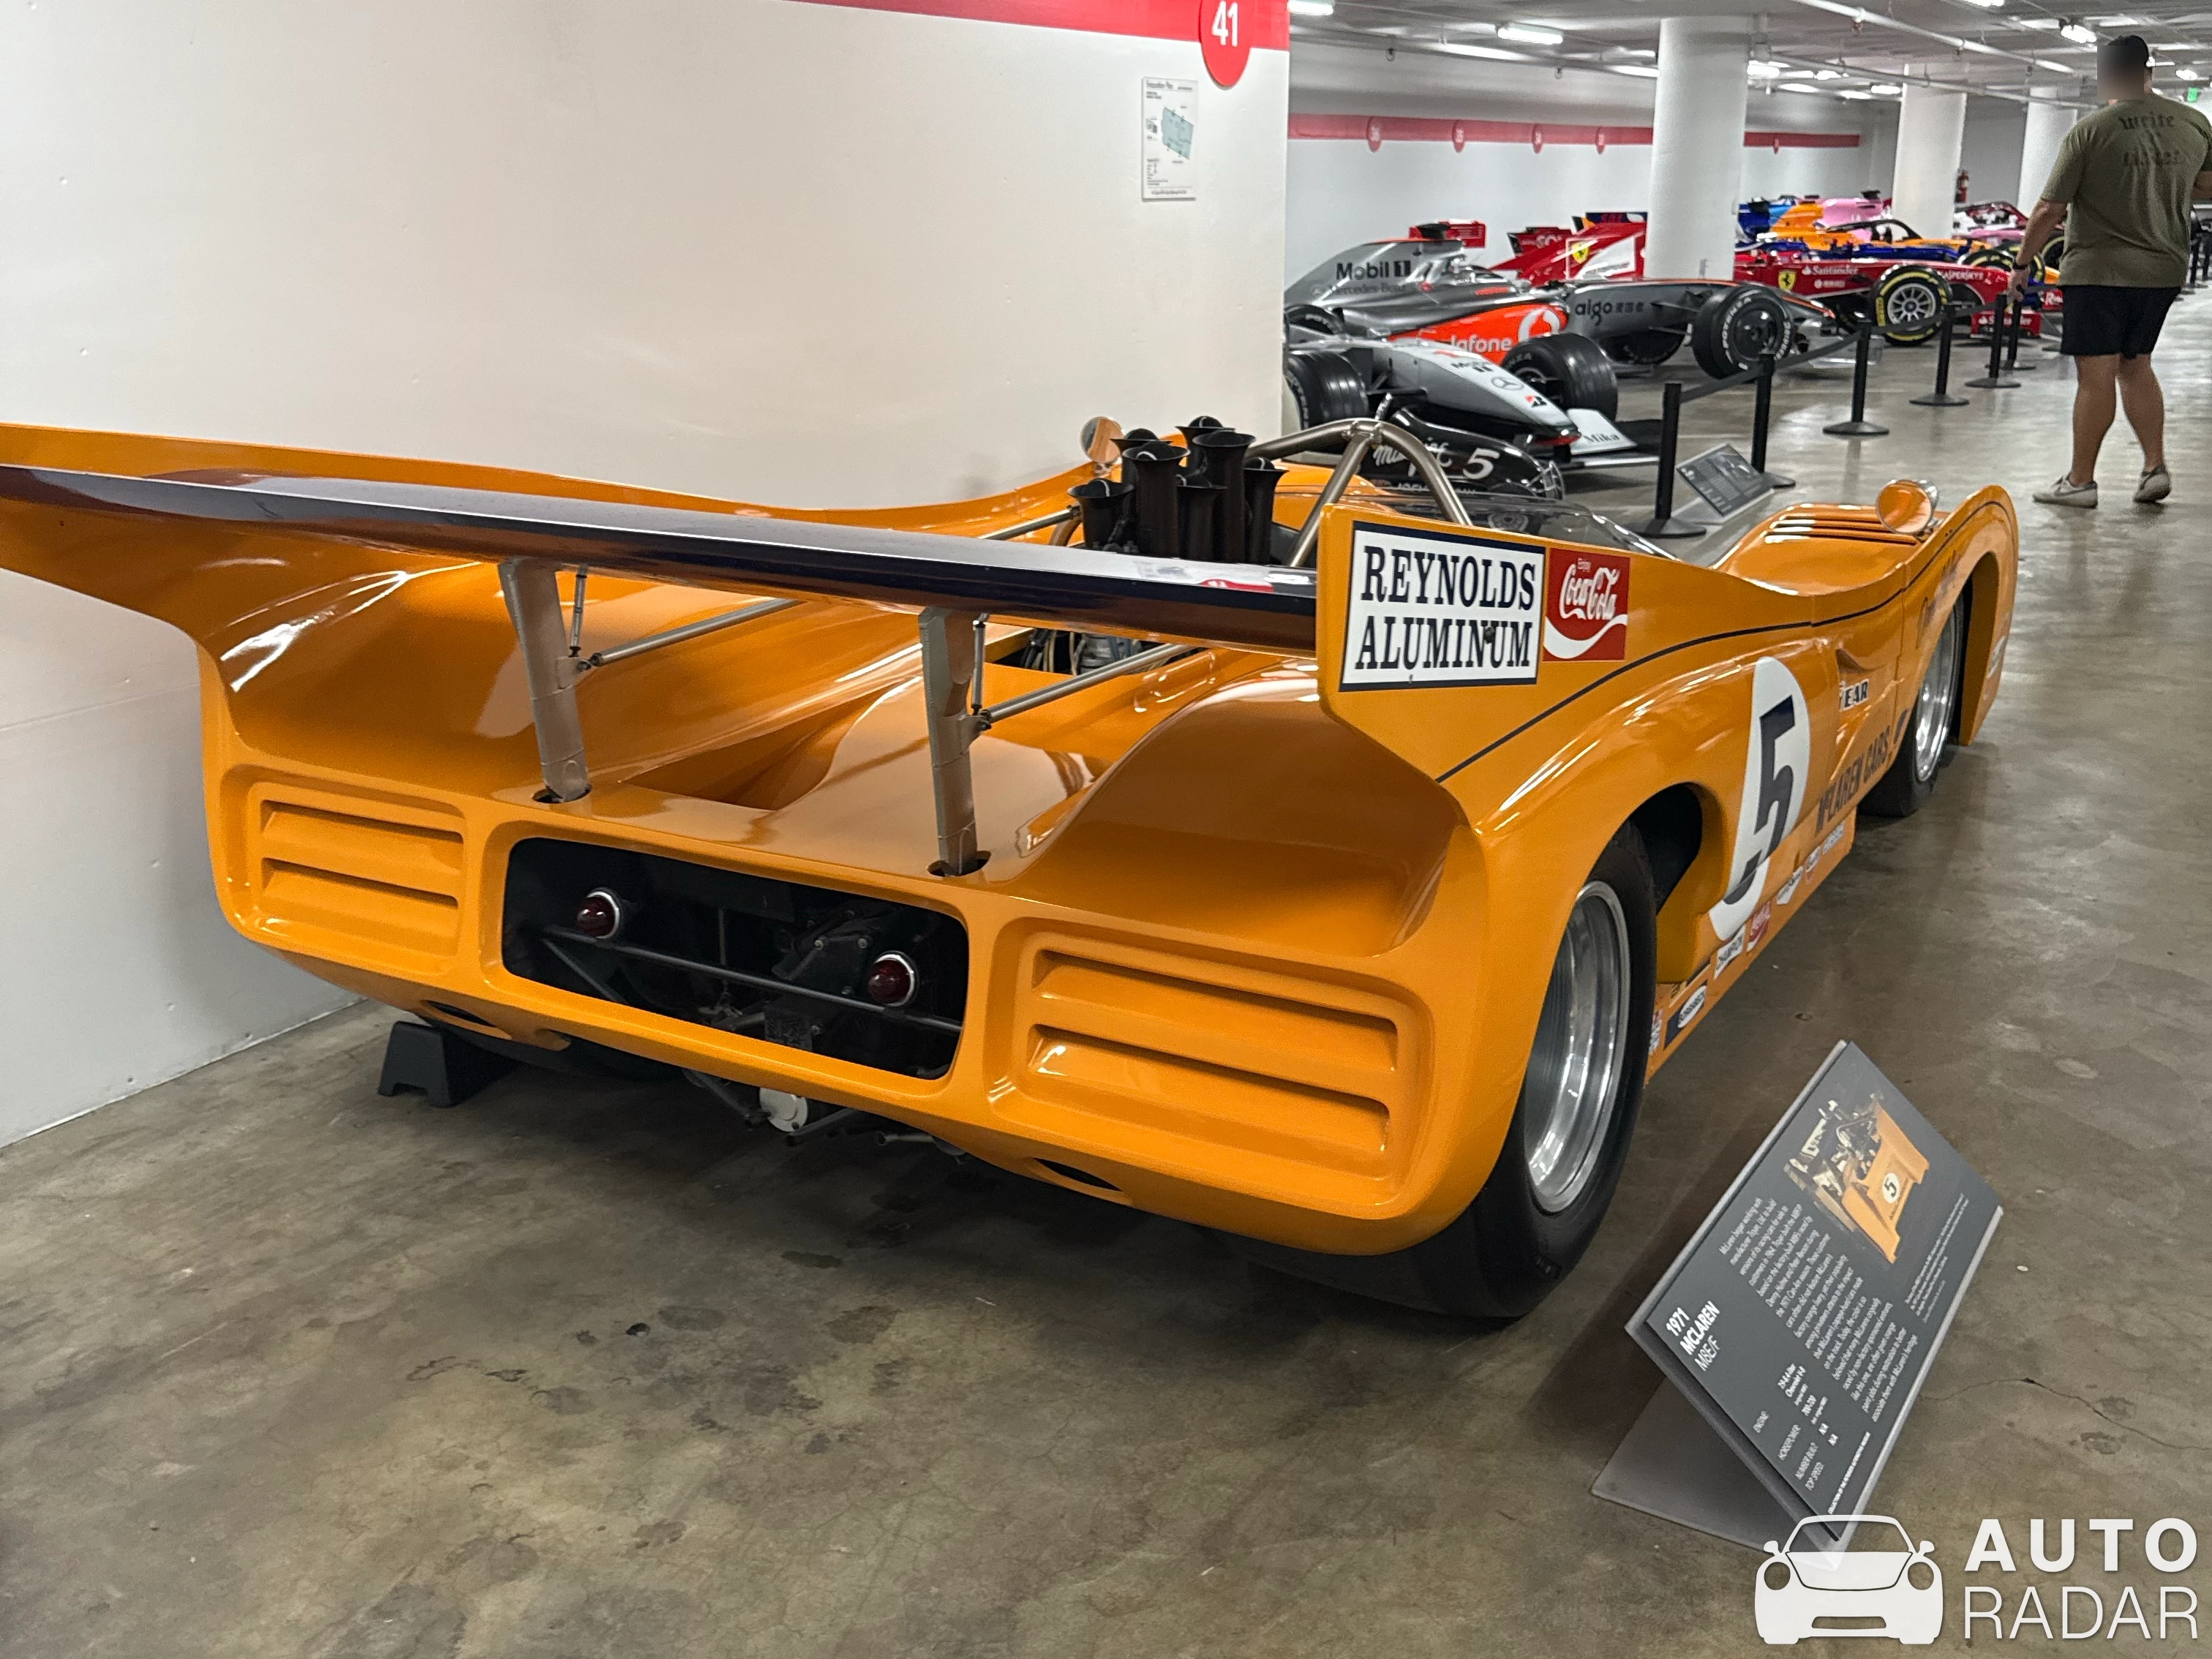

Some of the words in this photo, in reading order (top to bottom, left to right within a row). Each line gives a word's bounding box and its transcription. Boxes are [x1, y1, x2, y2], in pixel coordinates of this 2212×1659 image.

[1212, 0, 1238, 47] 41
[1336, 261, 1389, 280] Mobil
[1463, 448, 1500, 479] 5
[1361, 545, 1535, 610] REYNOLDS
[1355, 615, 1533, 670] ALUMINUM
[1723, 693, 1796, 906] 5
[1881, 1176, 1898, 1198] 5
[1666, 1307, 1690, 1336] 1971
[1679, 1301, 1720, 1355] MCLAREN
